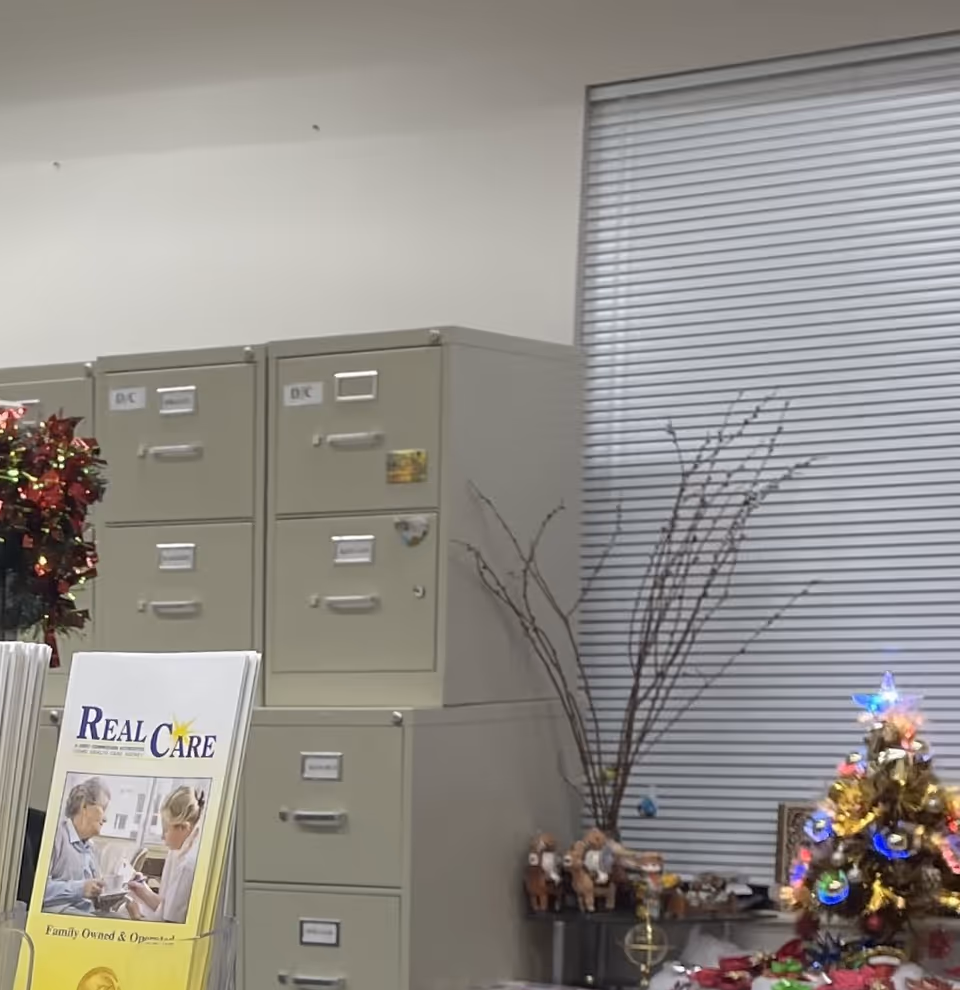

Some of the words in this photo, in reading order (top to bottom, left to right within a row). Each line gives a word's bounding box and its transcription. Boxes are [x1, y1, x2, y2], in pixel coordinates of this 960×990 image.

[76, 705, 147, 743] REAL
[150, 722, 217, 759] CARE
[45, 924, 80, 940] Family
[81, 927, 116, 941] Owned
[117, 931, 126, 942] &
